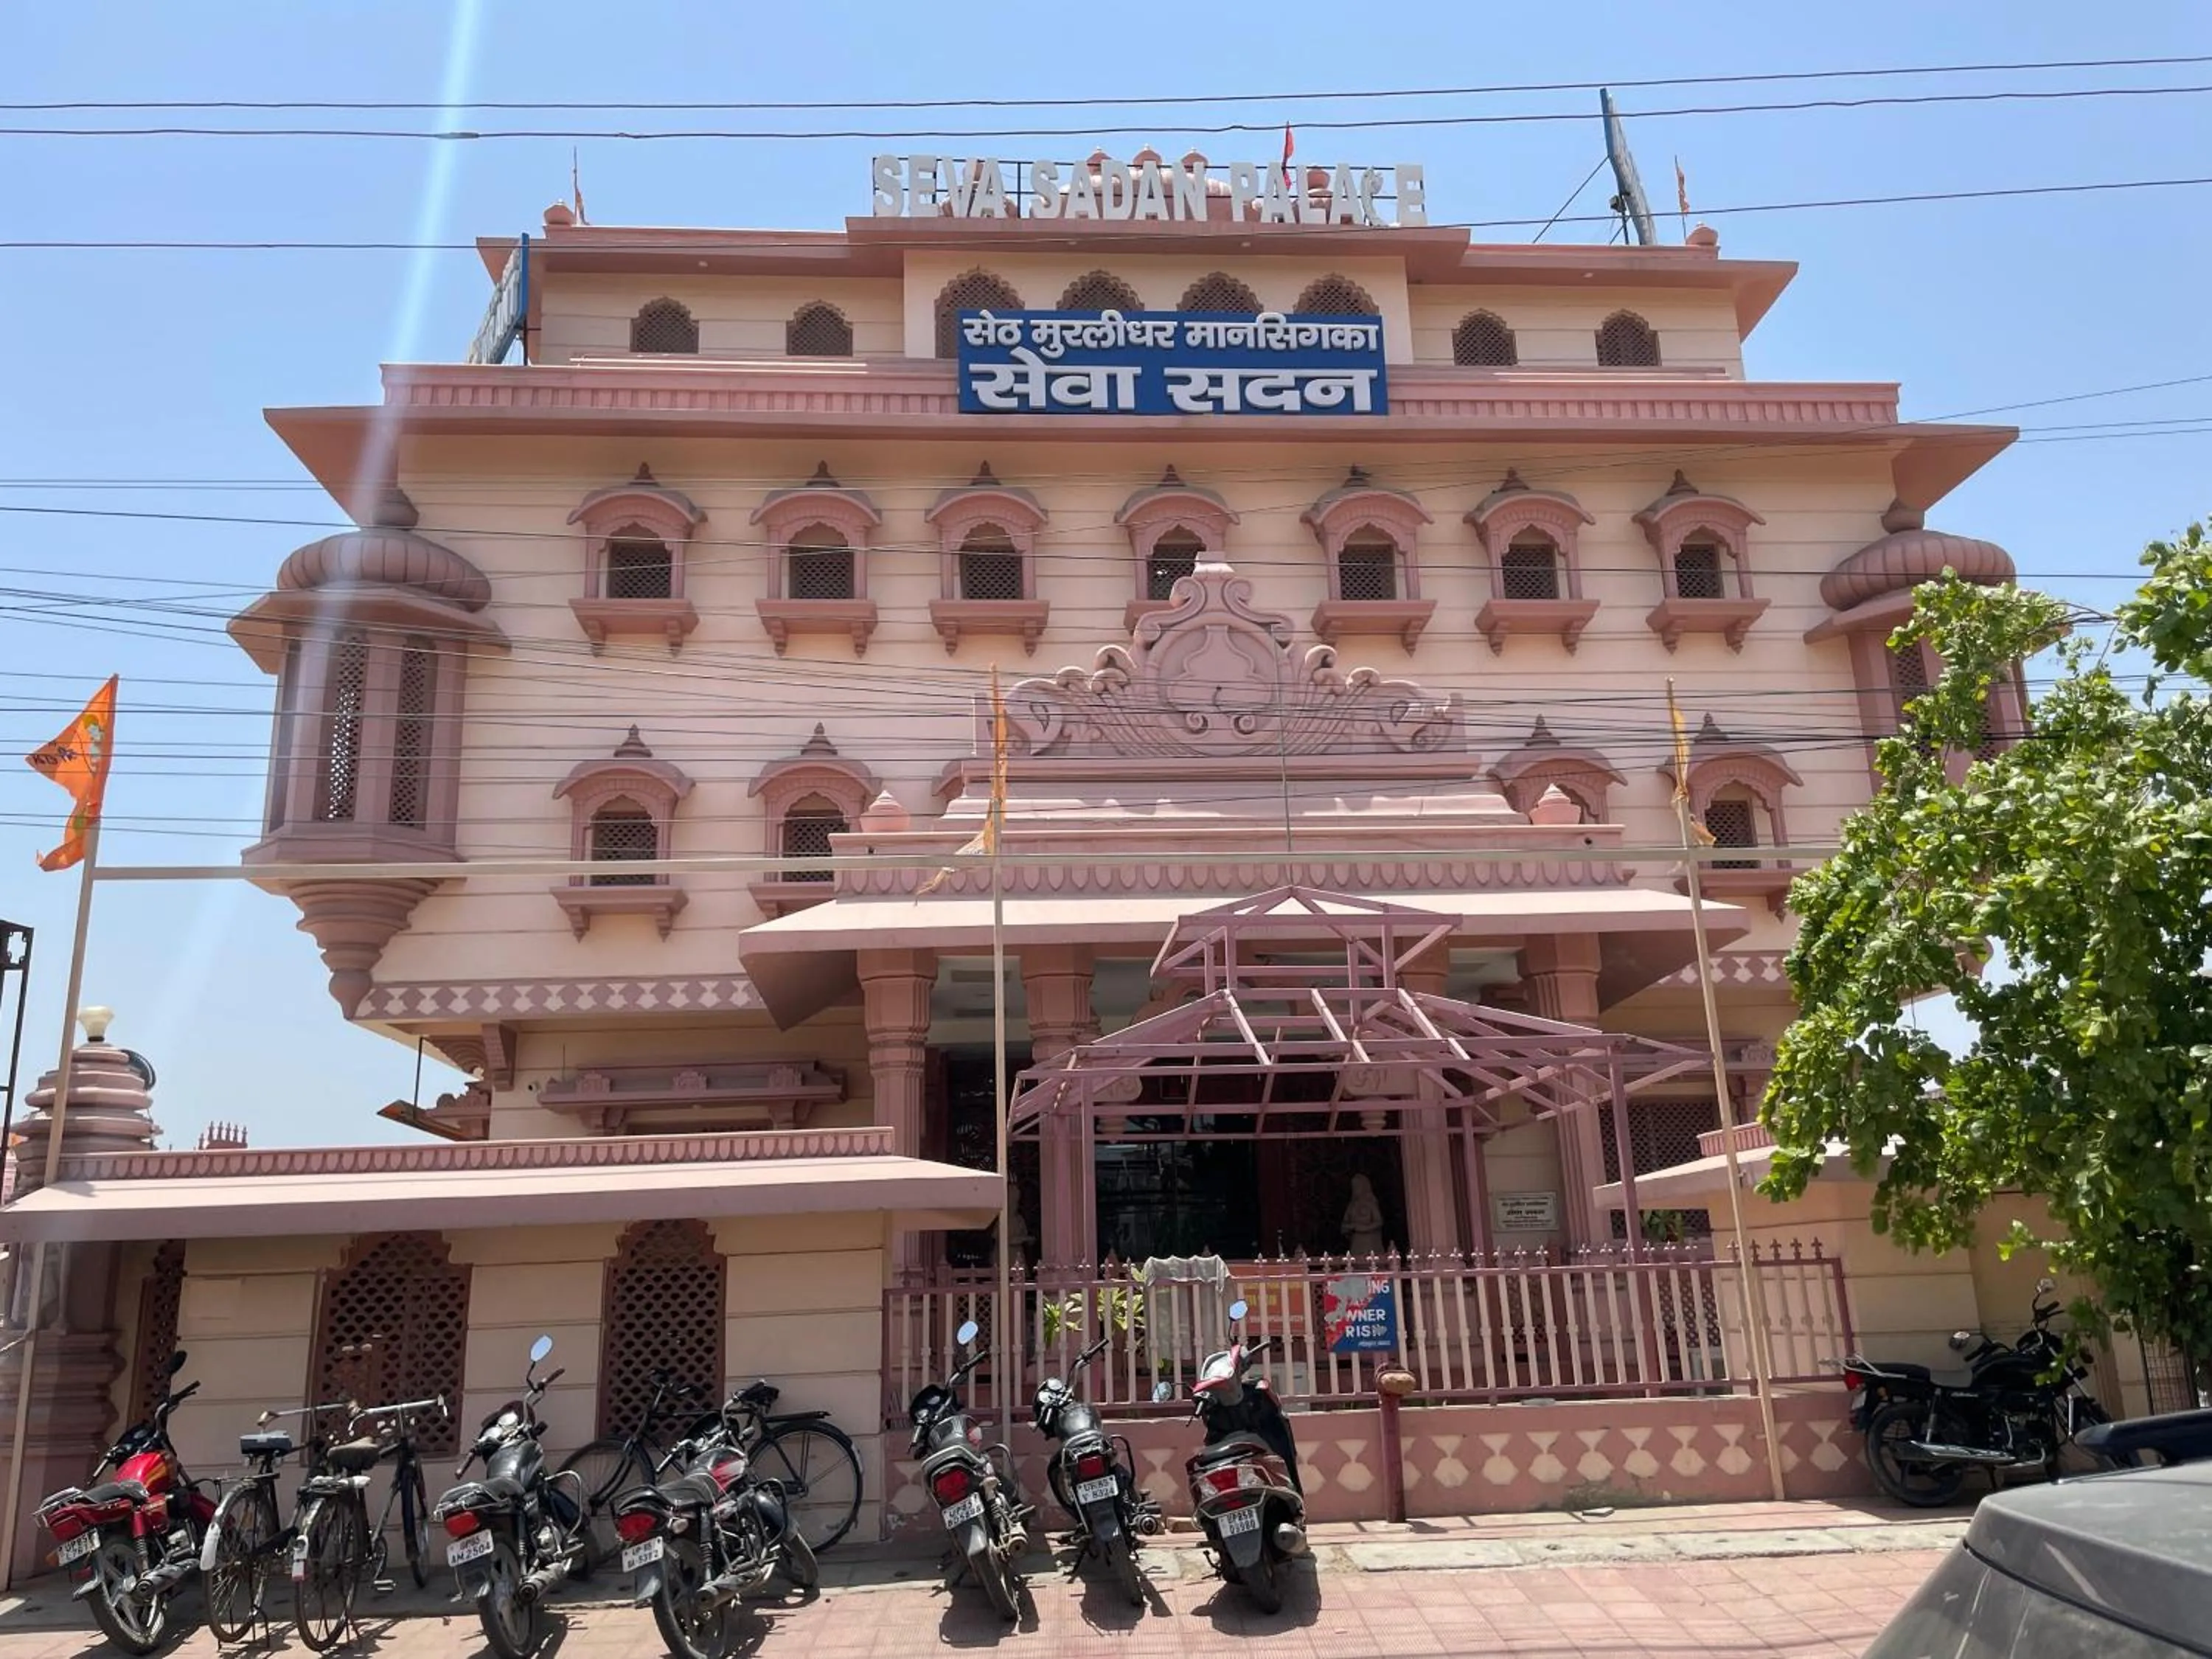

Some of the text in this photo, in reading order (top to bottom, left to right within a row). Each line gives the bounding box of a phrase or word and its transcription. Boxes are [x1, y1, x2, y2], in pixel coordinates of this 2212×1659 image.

[873, 154, 1428, 226] SEVA SADAN PALACE
[962, 309, 1023, 347] सेठ
[1030, 310, 1178, 359] मुरलीधर
[969, 346, 1378, 412] सेवा सदन
[1337, 1309, 1386, 1322] WNER
